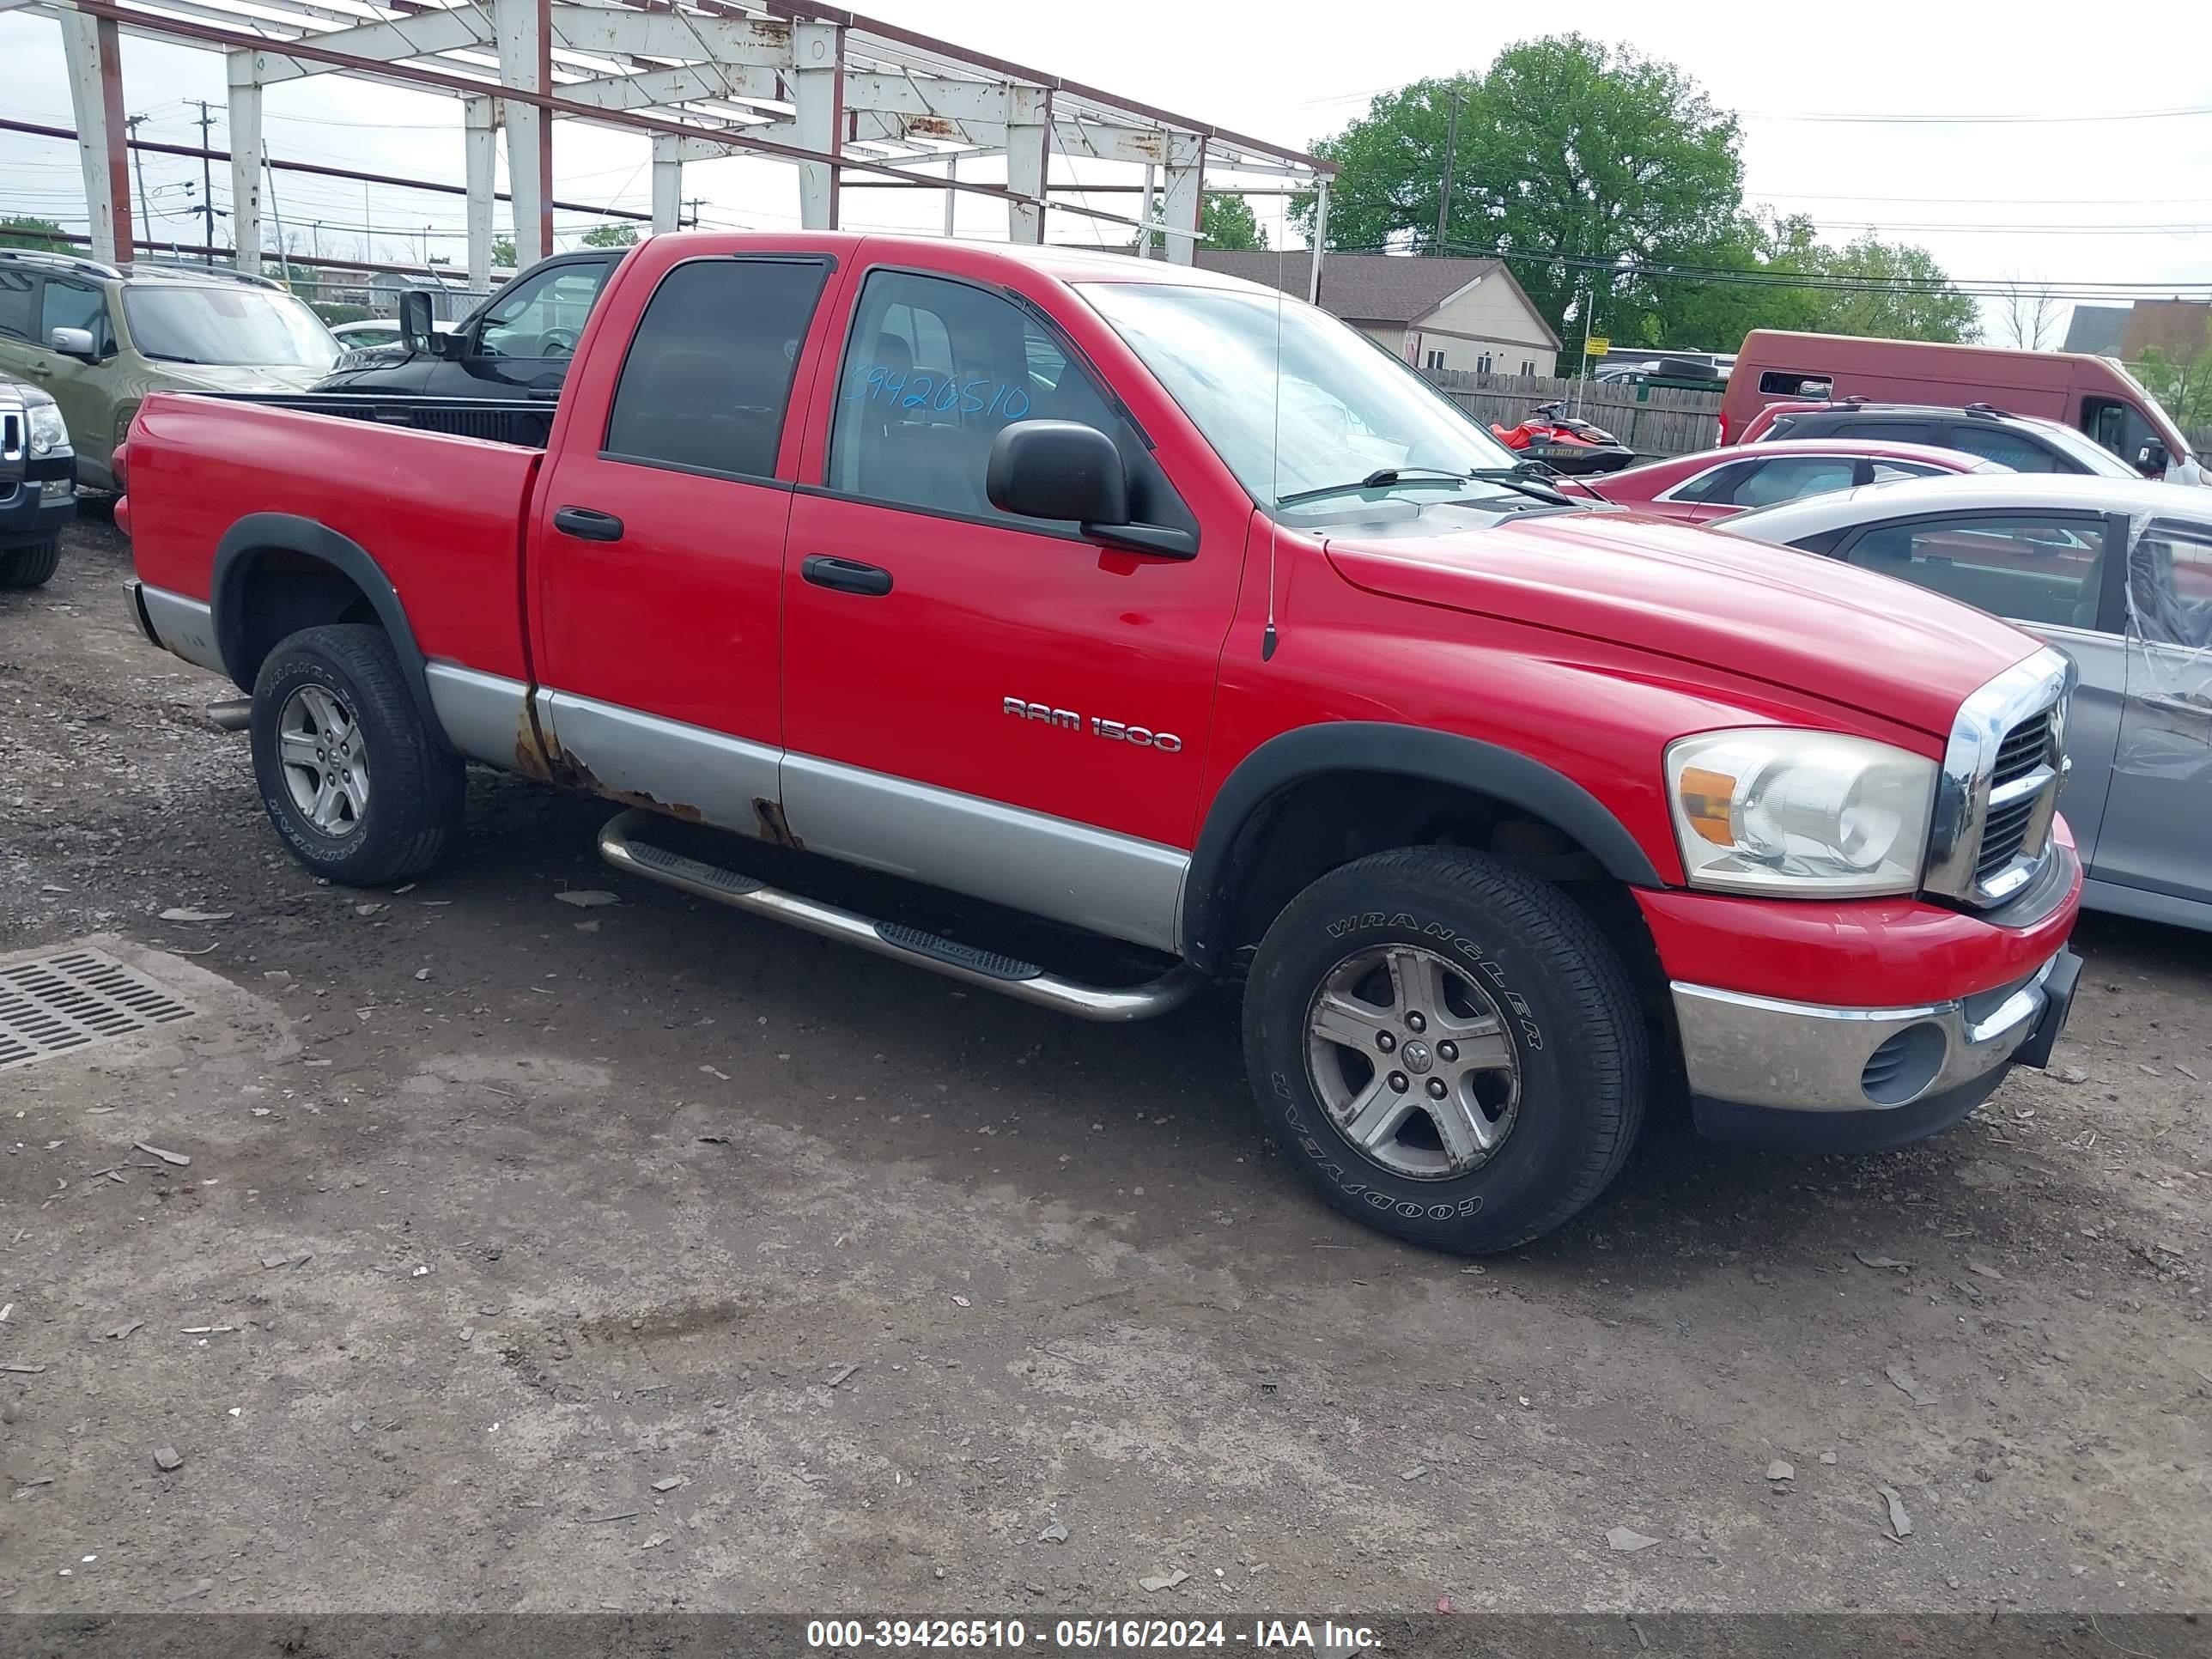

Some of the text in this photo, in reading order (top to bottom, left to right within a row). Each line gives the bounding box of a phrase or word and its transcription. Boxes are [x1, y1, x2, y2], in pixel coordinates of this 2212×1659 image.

[844, 363, 1030, 420] 39426510
[1003, 696, 1182, 753] RAM 1500
[1326, 912, 1544, 1052] WRANGLER
[1271, 1071, 1485, 1221] GOODYEAR
